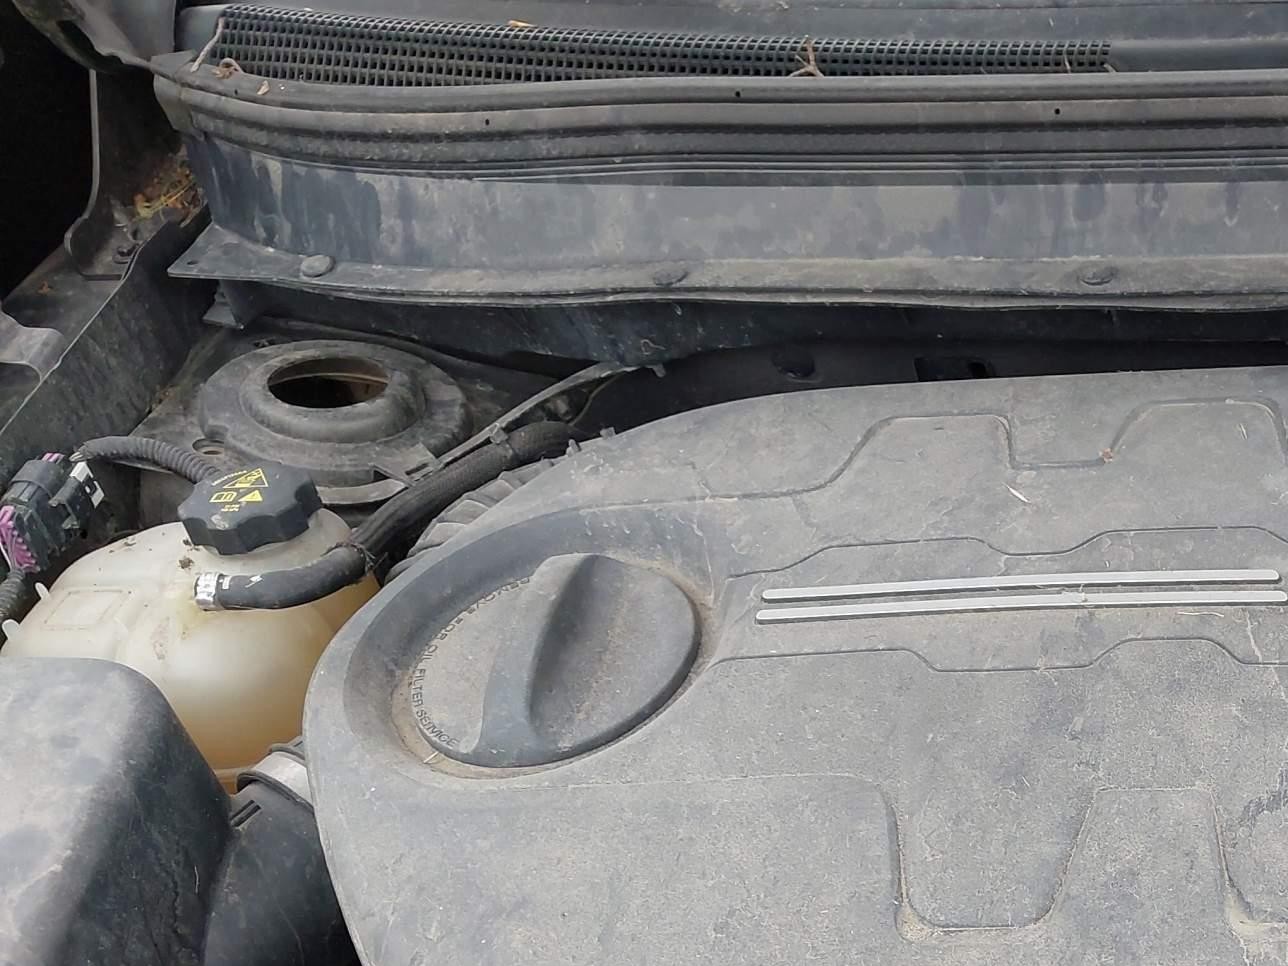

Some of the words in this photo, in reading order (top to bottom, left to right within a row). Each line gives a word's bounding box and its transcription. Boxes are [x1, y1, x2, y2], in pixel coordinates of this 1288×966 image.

[437, 616, 464, 641] FOR
[421, 643, 438, 662] OIL
[411, 667, 426, 708] FILTER
[416, 709, 460, 748] SERVICE
